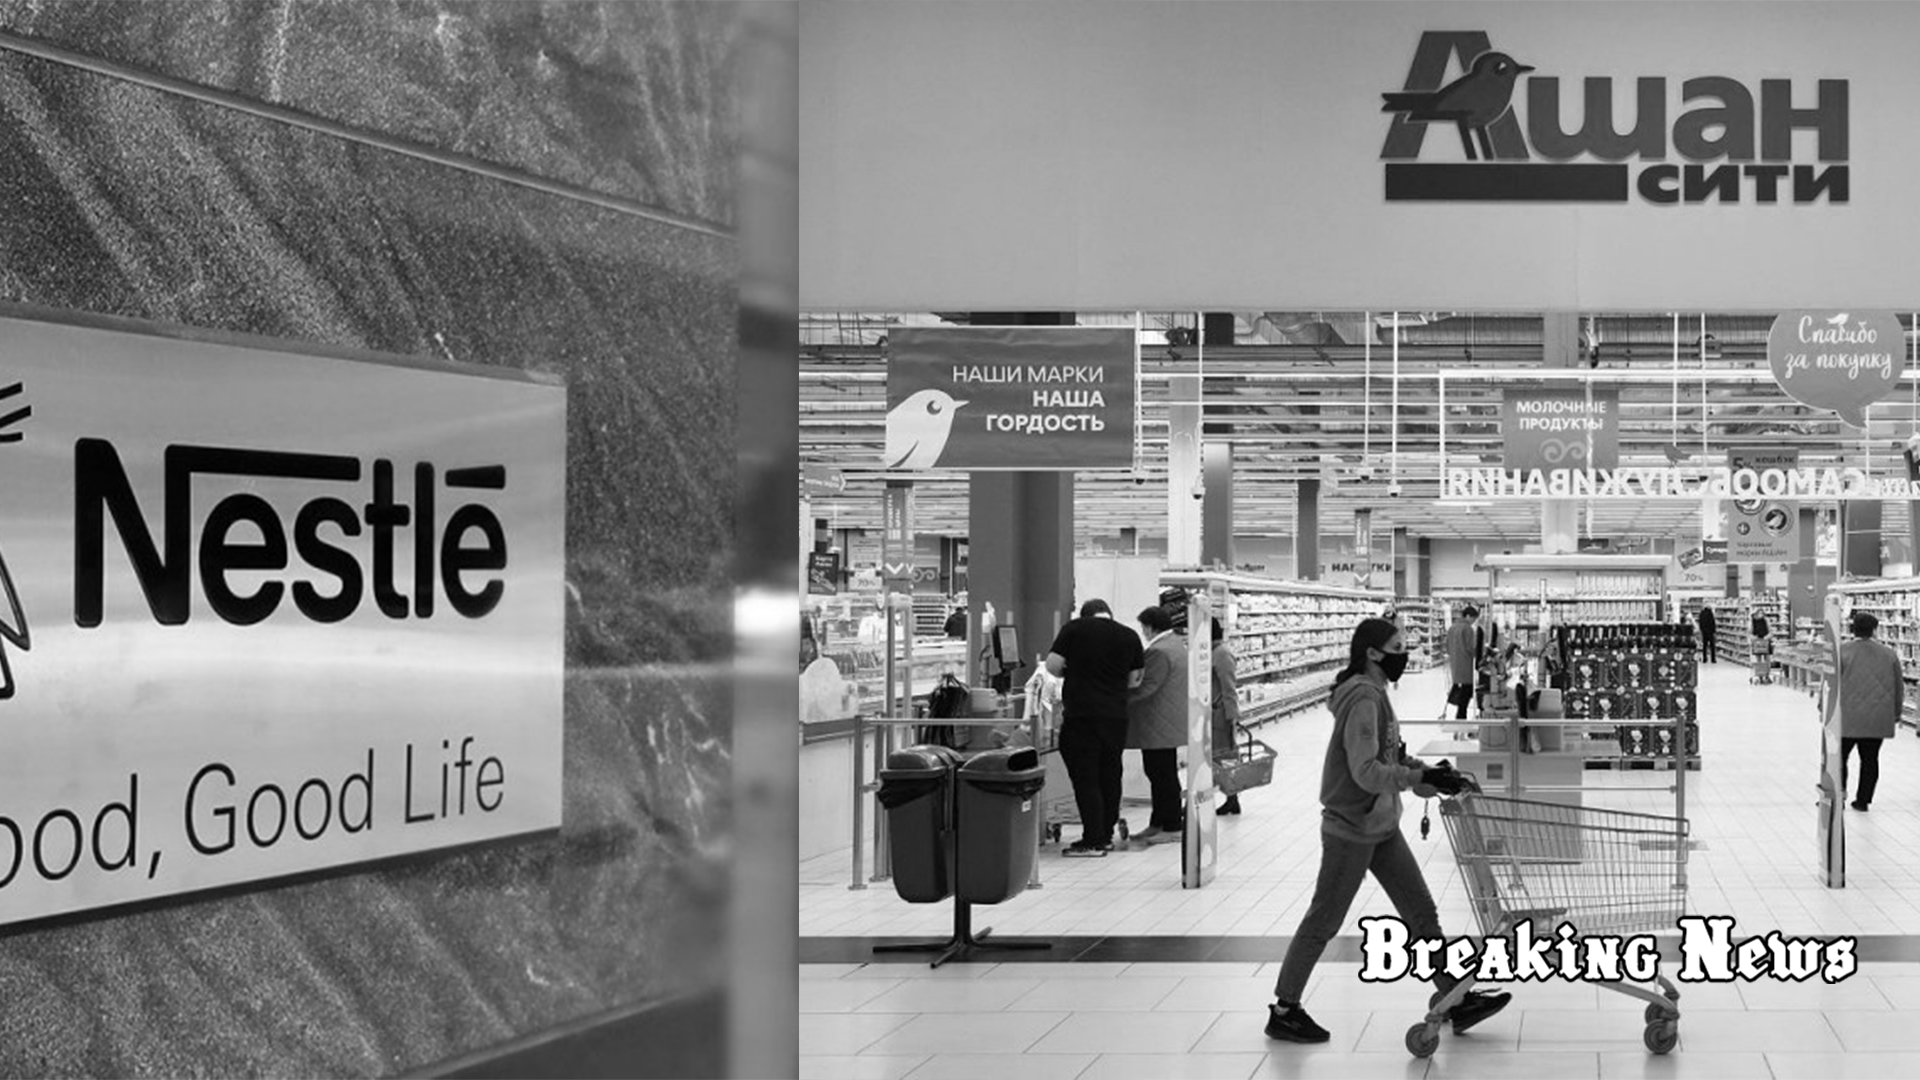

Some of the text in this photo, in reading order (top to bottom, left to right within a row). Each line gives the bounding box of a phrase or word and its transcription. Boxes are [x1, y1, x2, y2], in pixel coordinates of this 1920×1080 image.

[1379, 30, 1849, 162] Ашан
[1798, 314, 1878, 344] Спасибо
[953, 365, 1104, 383] НАШИ МАРКИ
[1784, 352, 1892, 379] за покупку
[1033, 390, 1106, 407] НАША
[986, 414, 1105, 434] ГОРДОСТЬ
[1519, 417, 1603, 431] ПРОДУКТЫ
[74, 437, 507, 628] Nestlé
[184, 748, 374, 856] Good
[404, 736, 505, 825] Life
